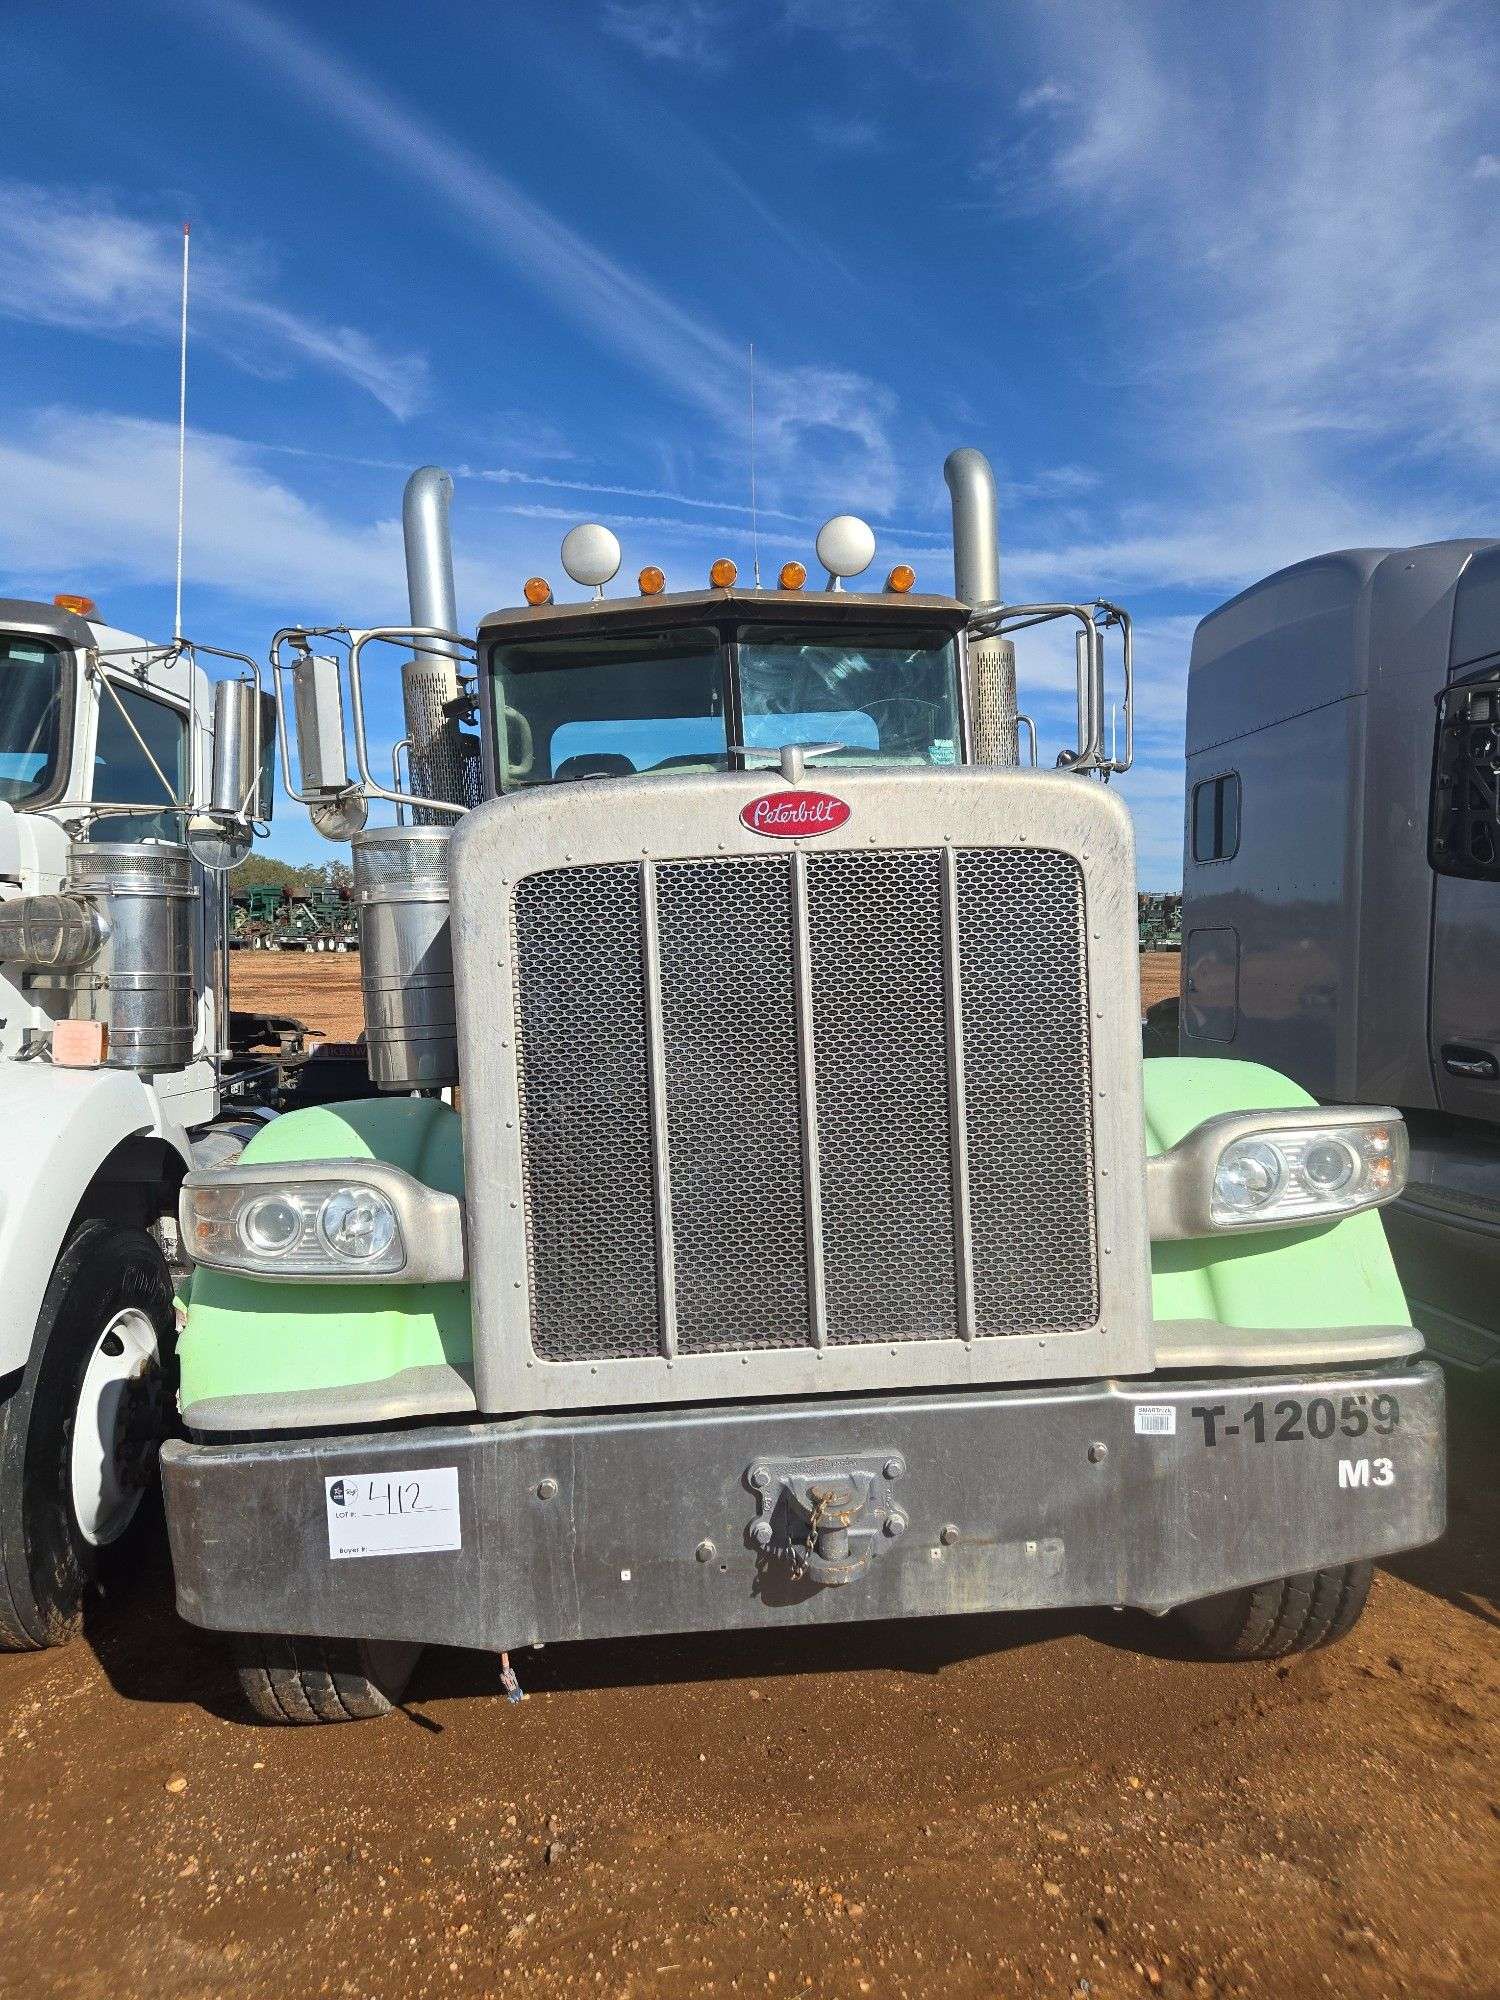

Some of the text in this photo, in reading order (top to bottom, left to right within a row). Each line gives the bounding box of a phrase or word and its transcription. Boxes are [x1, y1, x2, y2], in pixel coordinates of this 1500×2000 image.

[754, 800, 842, 827] Peterbilt
[1192, 1393, 1400, 1447] T-12059
[1338, 1457, 1394, 1488] M3
[368, 1481, 433, 1514] 412
[335, 1511, 349, 1519] LOT
